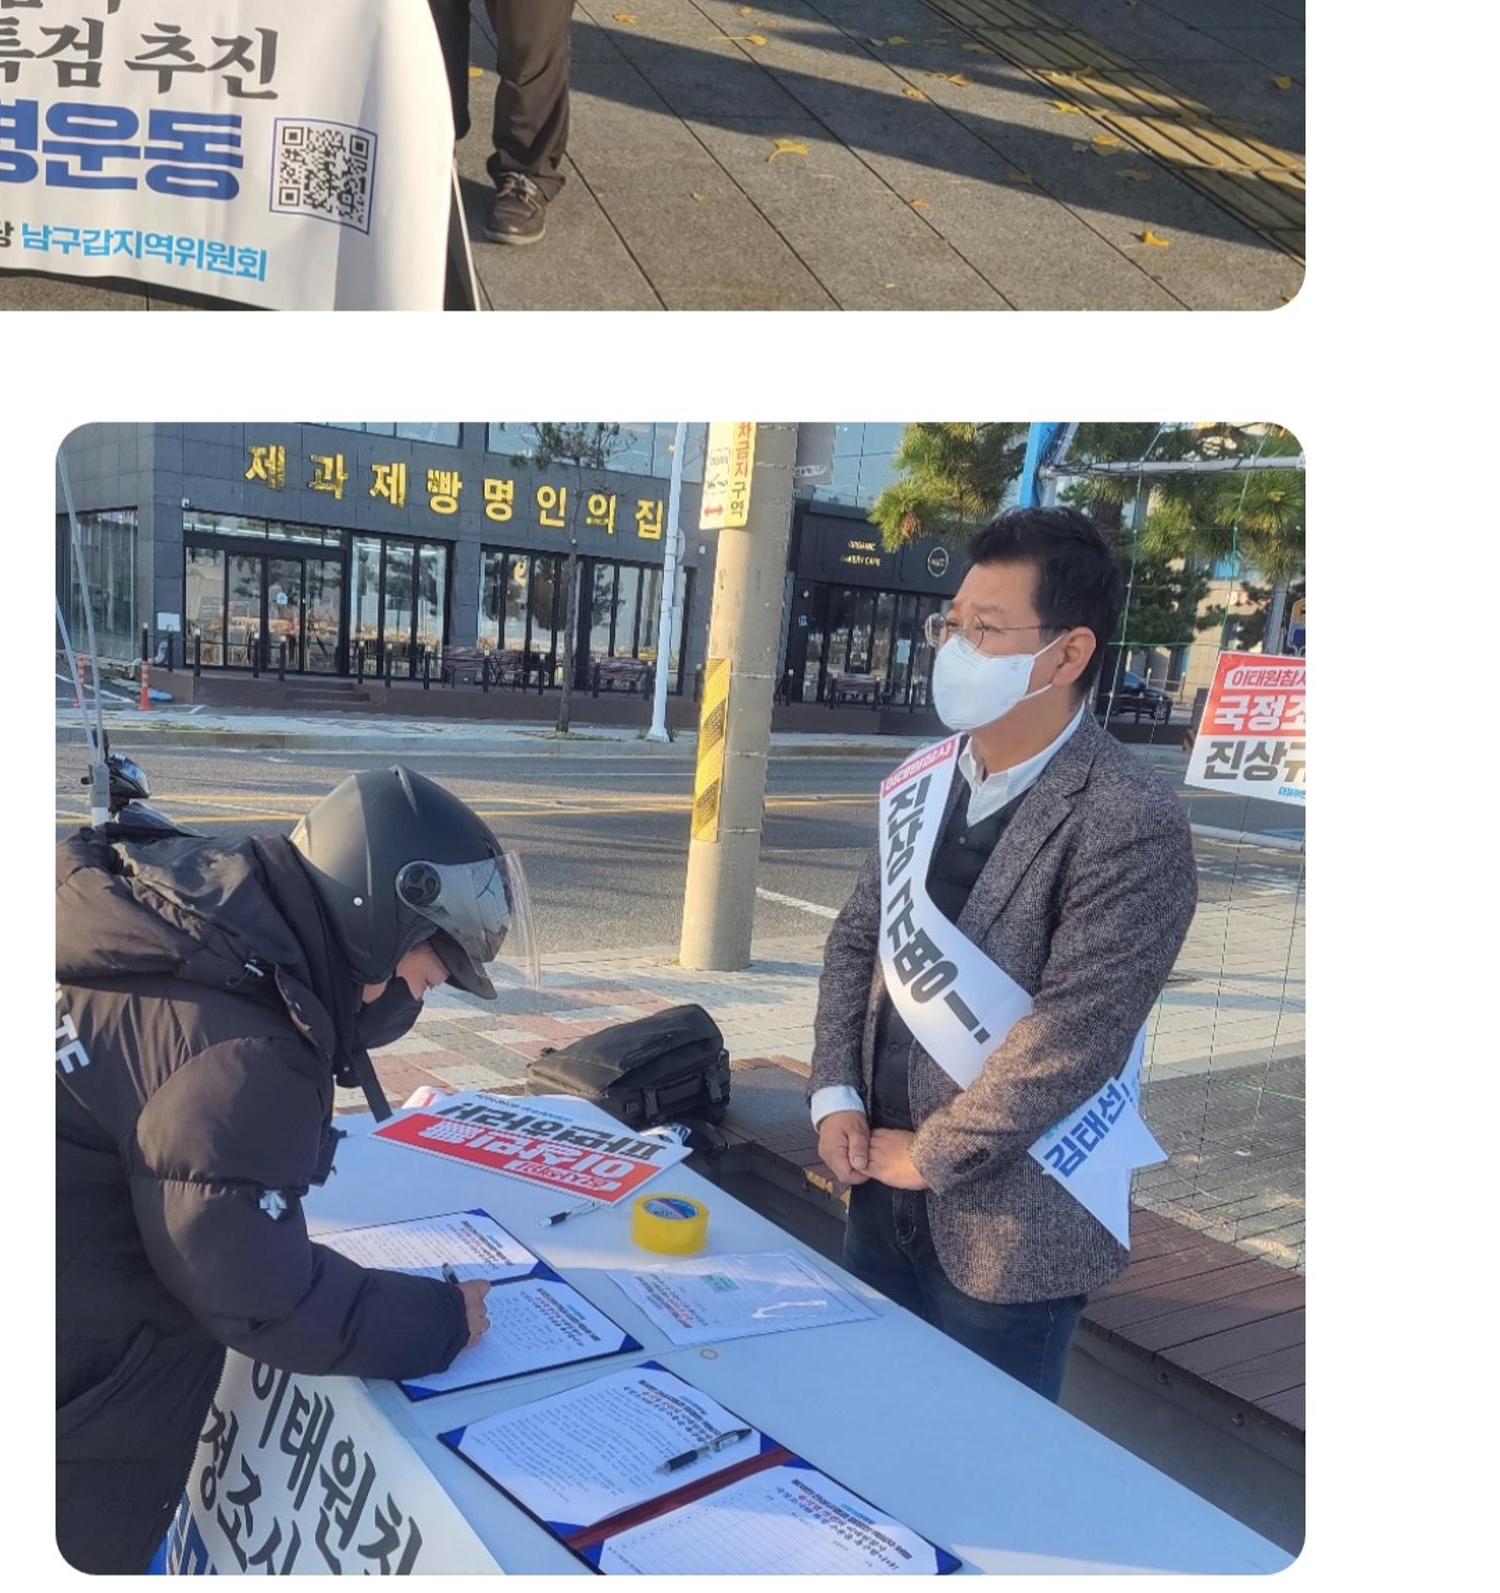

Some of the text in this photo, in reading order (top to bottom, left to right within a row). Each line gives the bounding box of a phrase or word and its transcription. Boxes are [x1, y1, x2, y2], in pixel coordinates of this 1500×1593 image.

[122, 22, 281, 101] 추진
[20, 220, 269, 284] 남구갑지역위원회
[1043, 1079, 1127, 1178] 김태선
